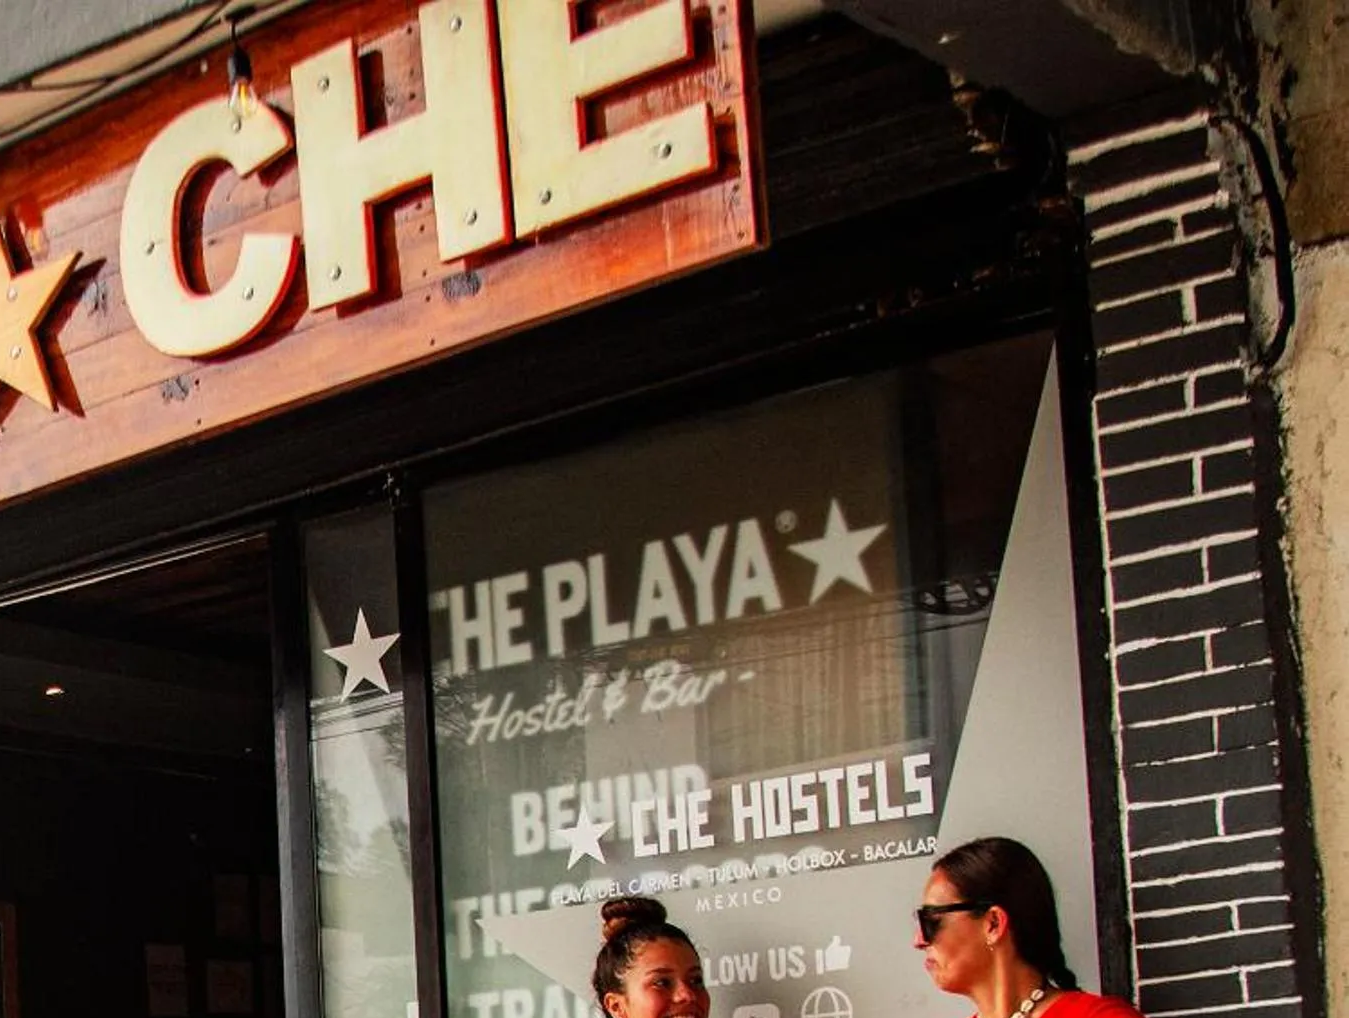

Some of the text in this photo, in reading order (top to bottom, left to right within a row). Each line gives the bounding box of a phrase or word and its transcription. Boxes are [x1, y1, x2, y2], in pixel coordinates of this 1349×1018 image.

[119, 0, 719, 360] CHE
[542, 517, 784, 658] PLAYA
[466, 671, 592, 746] Hostel
[640, 658, 727, 714] Bar
[630, 752, 934, 858] CHE HOSTELS
[628, 873, 690, 895] CARMEN
[708, 863, 759, 884] TULUM
[776, 848, 846, 875] HOLBOX
[863, 835, 939, 862] BACALAR
[696, 885, 782, 912] MEXICO
[704, 945, 806, 987] LOW US
